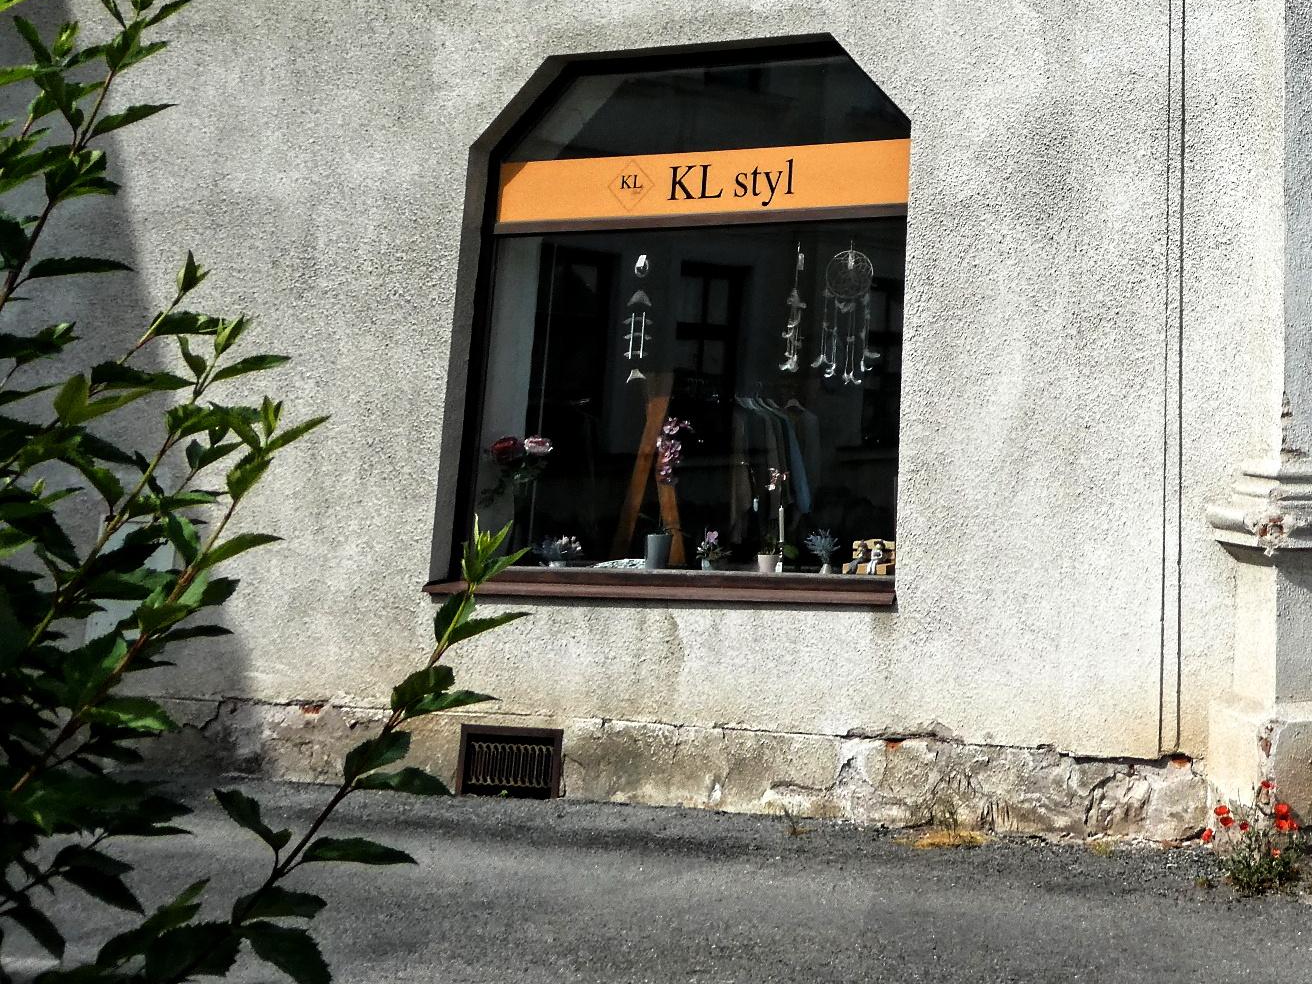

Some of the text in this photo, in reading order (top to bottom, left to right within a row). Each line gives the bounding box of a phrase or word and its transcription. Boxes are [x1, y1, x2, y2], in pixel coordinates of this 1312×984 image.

[619, 174, 644, 190] KL
[667, 158, 794, 207] KL styl
